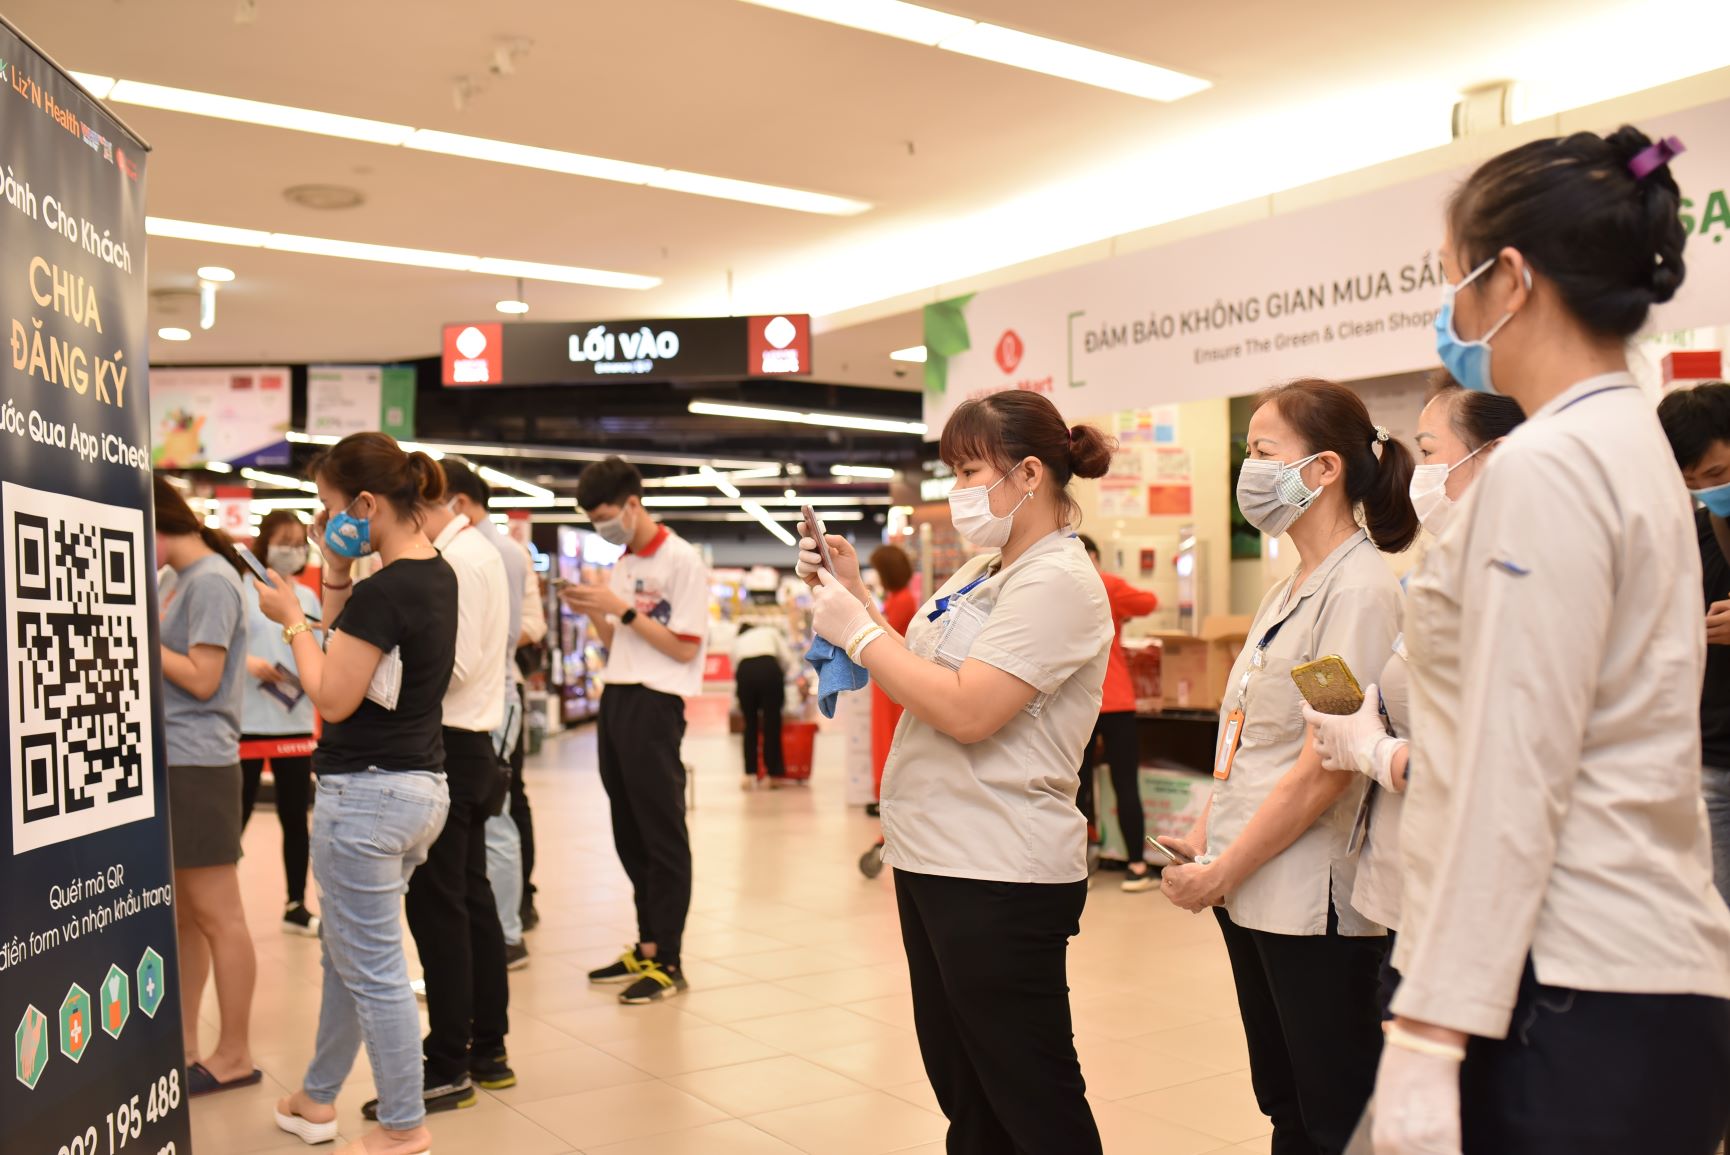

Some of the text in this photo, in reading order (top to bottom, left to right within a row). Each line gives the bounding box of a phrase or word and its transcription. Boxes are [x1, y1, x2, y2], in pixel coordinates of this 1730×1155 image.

[11, 65, 41, 110] Liz'N
[45, 91, 80, 138] Health
[43, 195, 78, 243] Cho
[81, 217, 131, 275] Khách
[29, 256, 103, 334] CHƯA
[1180, 297, 1261, 335] KHÔNG
[1266, 283, 1325, 318] GIAN
[1332, 271, 1393, 306] MUA
[10, 317, 128, 408] ĐĂNG KÝ
[618, 326, 680, 360] VÀO
[1193, 345, 1241, 365] Ensure
[1245, 337, 1271, 354] The
[1274, 330, 1320, 350] Green
[1324, 324, 1334, 342] &
[1338, 318, 1384, 340] Clean
[29, 409, 66, 449] Qua
[70, 423, 98, 463] App
[101, 432, 150, 473] iCheck
[50, 863, 124, 910] Quét mã QR
[0, 884, 172, 972] điền form và nhận khẩu trang
[106, 1094, 142, 1155] 195
[146, 1068, 180, 1124] 488
